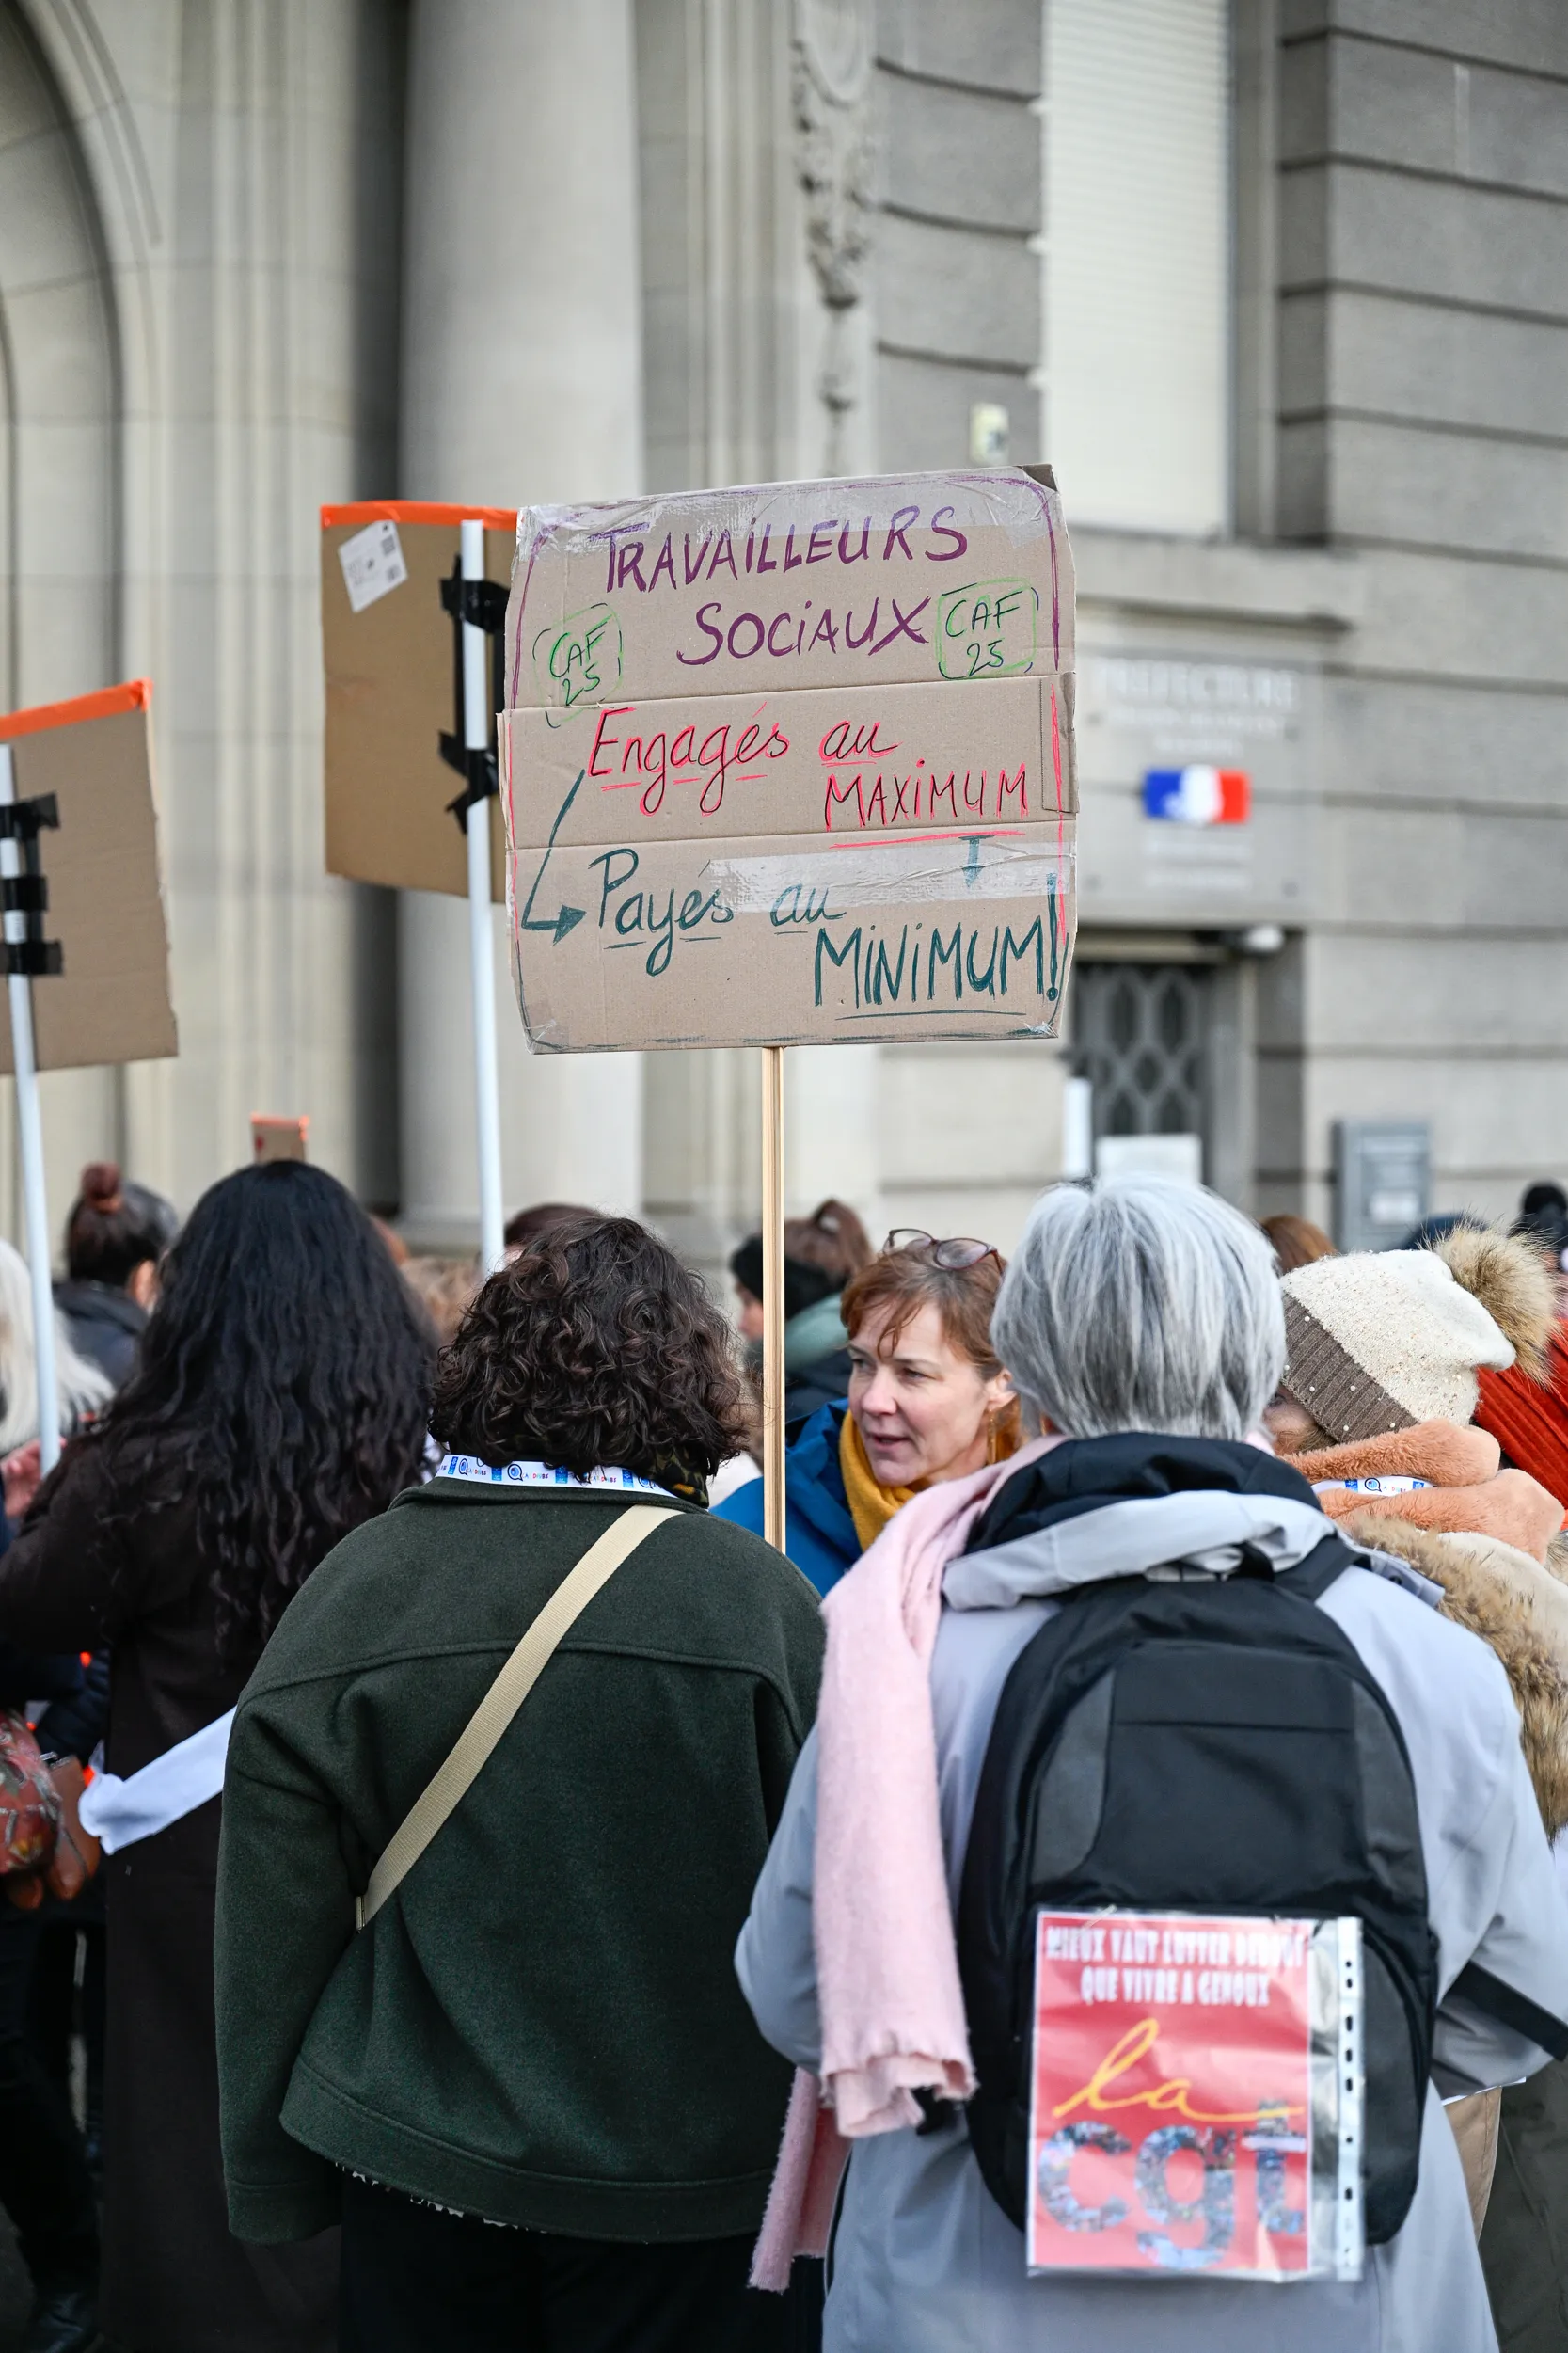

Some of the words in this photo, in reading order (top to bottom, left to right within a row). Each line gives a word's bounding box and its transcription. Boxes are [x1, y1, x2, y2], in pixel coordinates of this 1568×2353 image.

[945, 587, 1024, 638] CAF
[548, 619, 608, 678] CAF
[967, 642, 1005, 677] 25
[562, 669, 602, 706] 25
[589, 701, 790, 816] Engagés
[819, 720, 904, 763] au
[588, 849, 734, 978] Payés
[770, 886, 847, 926] au
[1110, 1929, 1158, 1963] VAUT
[1163, 1930, 1230, 1965] LUTTER
[1081, 1966, 1119, 2005] QUE
[1122, 1967, 1177, 2002] VIVRE
[1198, 1971, 1270, 2007] GENOUX
[1052, 2018, 1307, 2122] la
[1038, 2098, 1308, 2269] cgt
